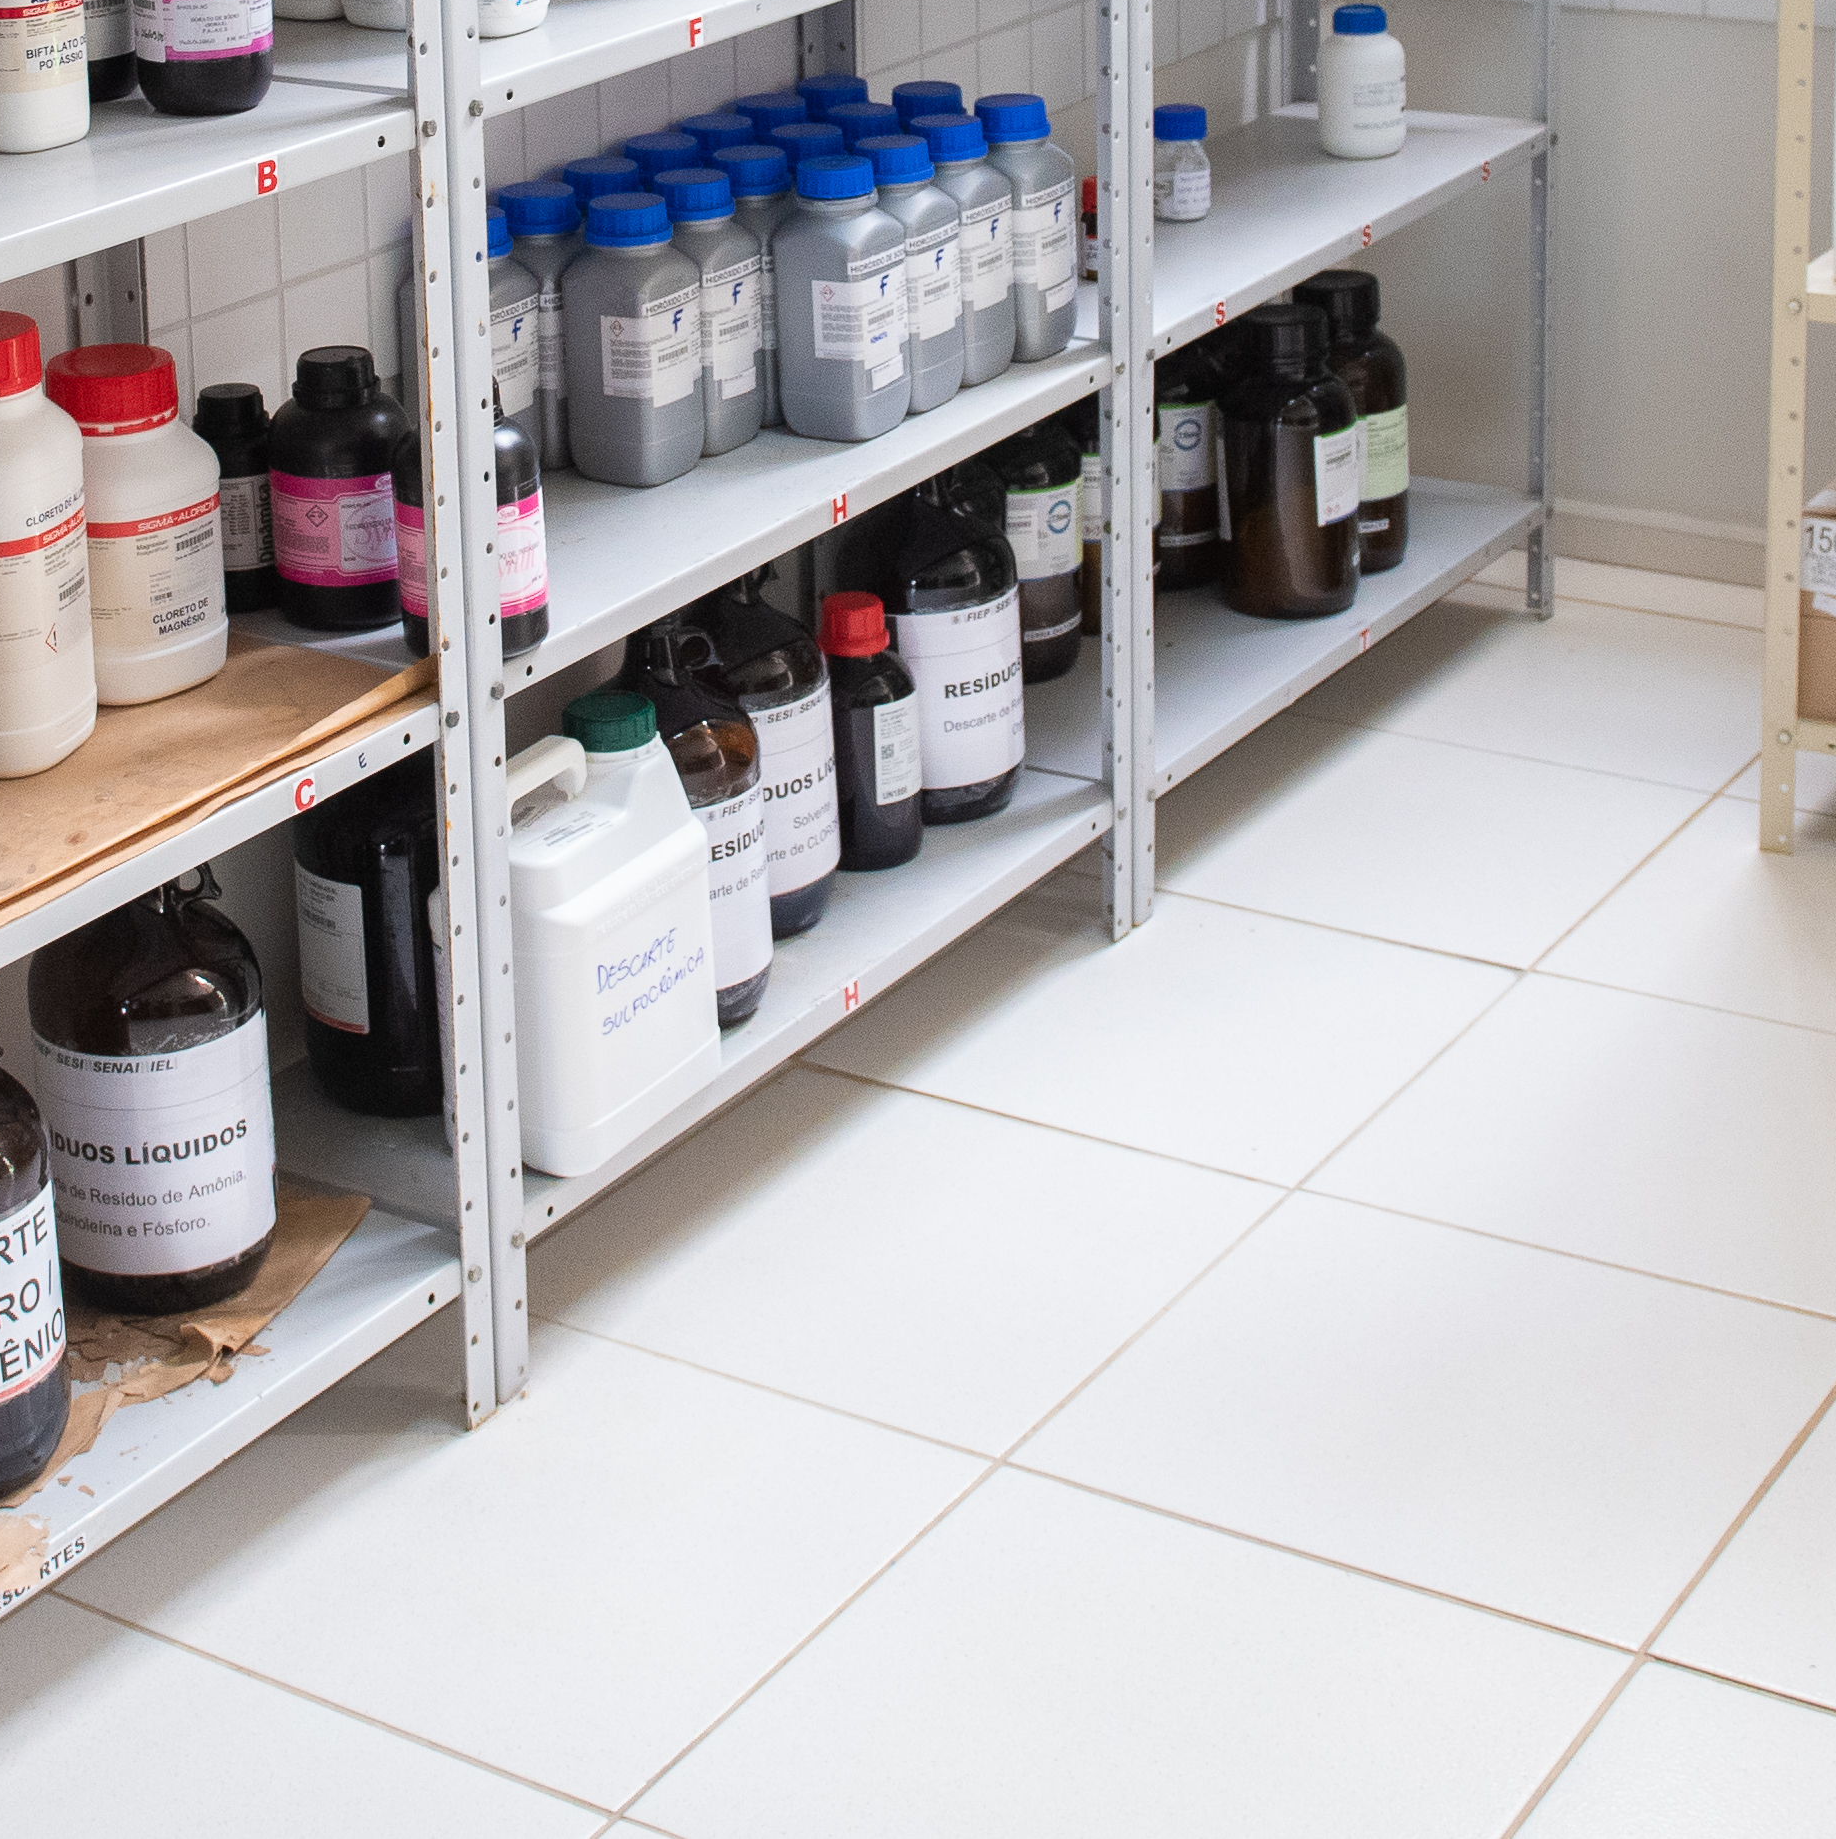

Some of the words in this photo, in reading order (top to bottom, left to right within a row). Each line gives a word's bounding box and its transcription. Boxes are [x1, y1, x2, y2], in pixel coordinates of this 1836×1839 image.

[689, 17, 702, 47] F
[25, 37, 78, 60] BIFTALATO
[38, 49, 84, 71] POTÁSSIO
[257, 160, 278, 196] B
[1482, 161, 1490, 183] S
[1362, 224, 1372, 247] S
[1215, 301, 1225, 326] S
[25, 501, 65, 528] CLORETO
[136, 500, 216, 533] SIGMA-ALDRICH
[833, 494, 847, 523] H
[152, 602, 197, 626] CLORETO
[198, 596, 210, 612] DE
[158, 611, 207, 636] MAGNÉSIO
[943, 712, 997, 734] Descarte
[294, 778, 316, 811] C
[595, 927, 677, 996] DESCARTE
[844, 982, 859, 1011] H
[56, 1053, 85, 1071] SESI
[92, 1060, 141, 1075] SENAI
[150, 1058, 175, 1073] IEL
[125, 1117, 248, 1166] LÍQUIDOS
[89, 1187, 158, 1207] Resíduo
[162, 1187, 183, 1206] de
